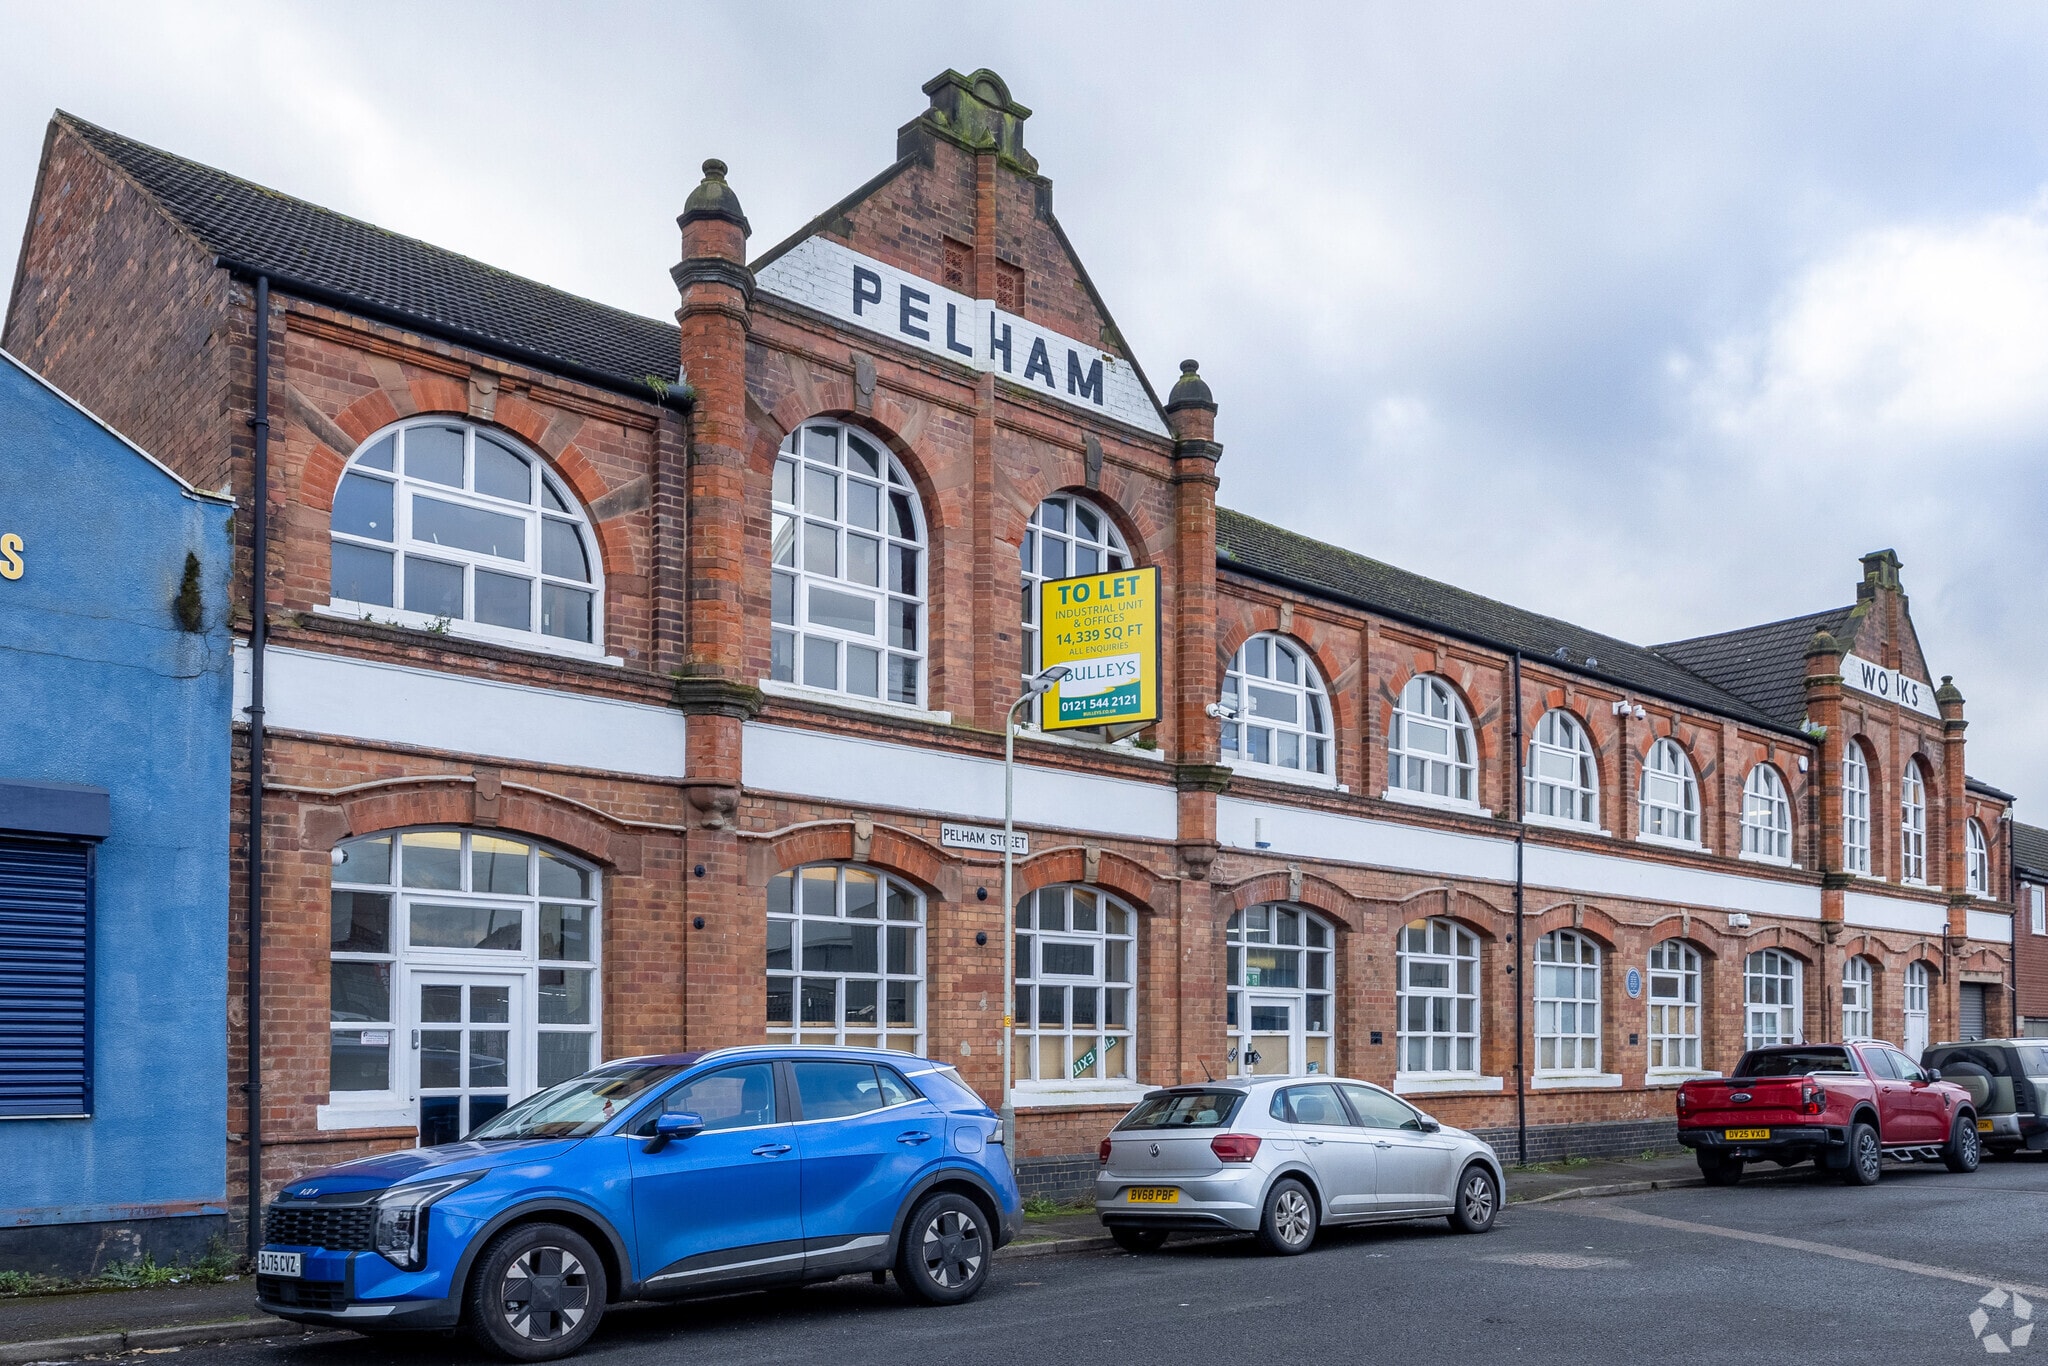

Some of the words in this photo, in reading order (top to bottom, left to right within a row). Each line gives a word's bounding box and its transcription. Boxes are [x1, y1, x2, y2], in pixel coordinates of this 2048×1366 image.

[853, 264, 1103, 406] PELHAM
[1058, 583, 1090, 605] TO
[1099, 575, 1140, 600] LET
[1056, 604, 1115, 619] INDUSTRIAL
[1118, 599, 1143, 611] UNIT
[1073, 618, 1081, 628] &
[1084, 613, 1125, 626] OFFICES
[1056, 629, 1100, 645] 14,339
[1104, 627, 1123, 640] SQ
[1127, 624, 1143, 636] FT
[1086, 642, 1129, 654] ENQUIRIES
[1064, 660, 1136, 682] BULLEYS
[1061, 700, 1086, 712] 0121
[1089, 697, 1109, 709] 544
[1111, 694, 1137, 707] 2121
[943, 828, 985, 844] PELHAM
[1073, 1051, 1096, 1077] EXIT
[1131, 1189, 1155, 1200] BV68
[1156, 1189, 1175, 1201] PBF
[261, 1253, 279, 1271] BJ75
[280, 1255, 296, 1273] CVZ
